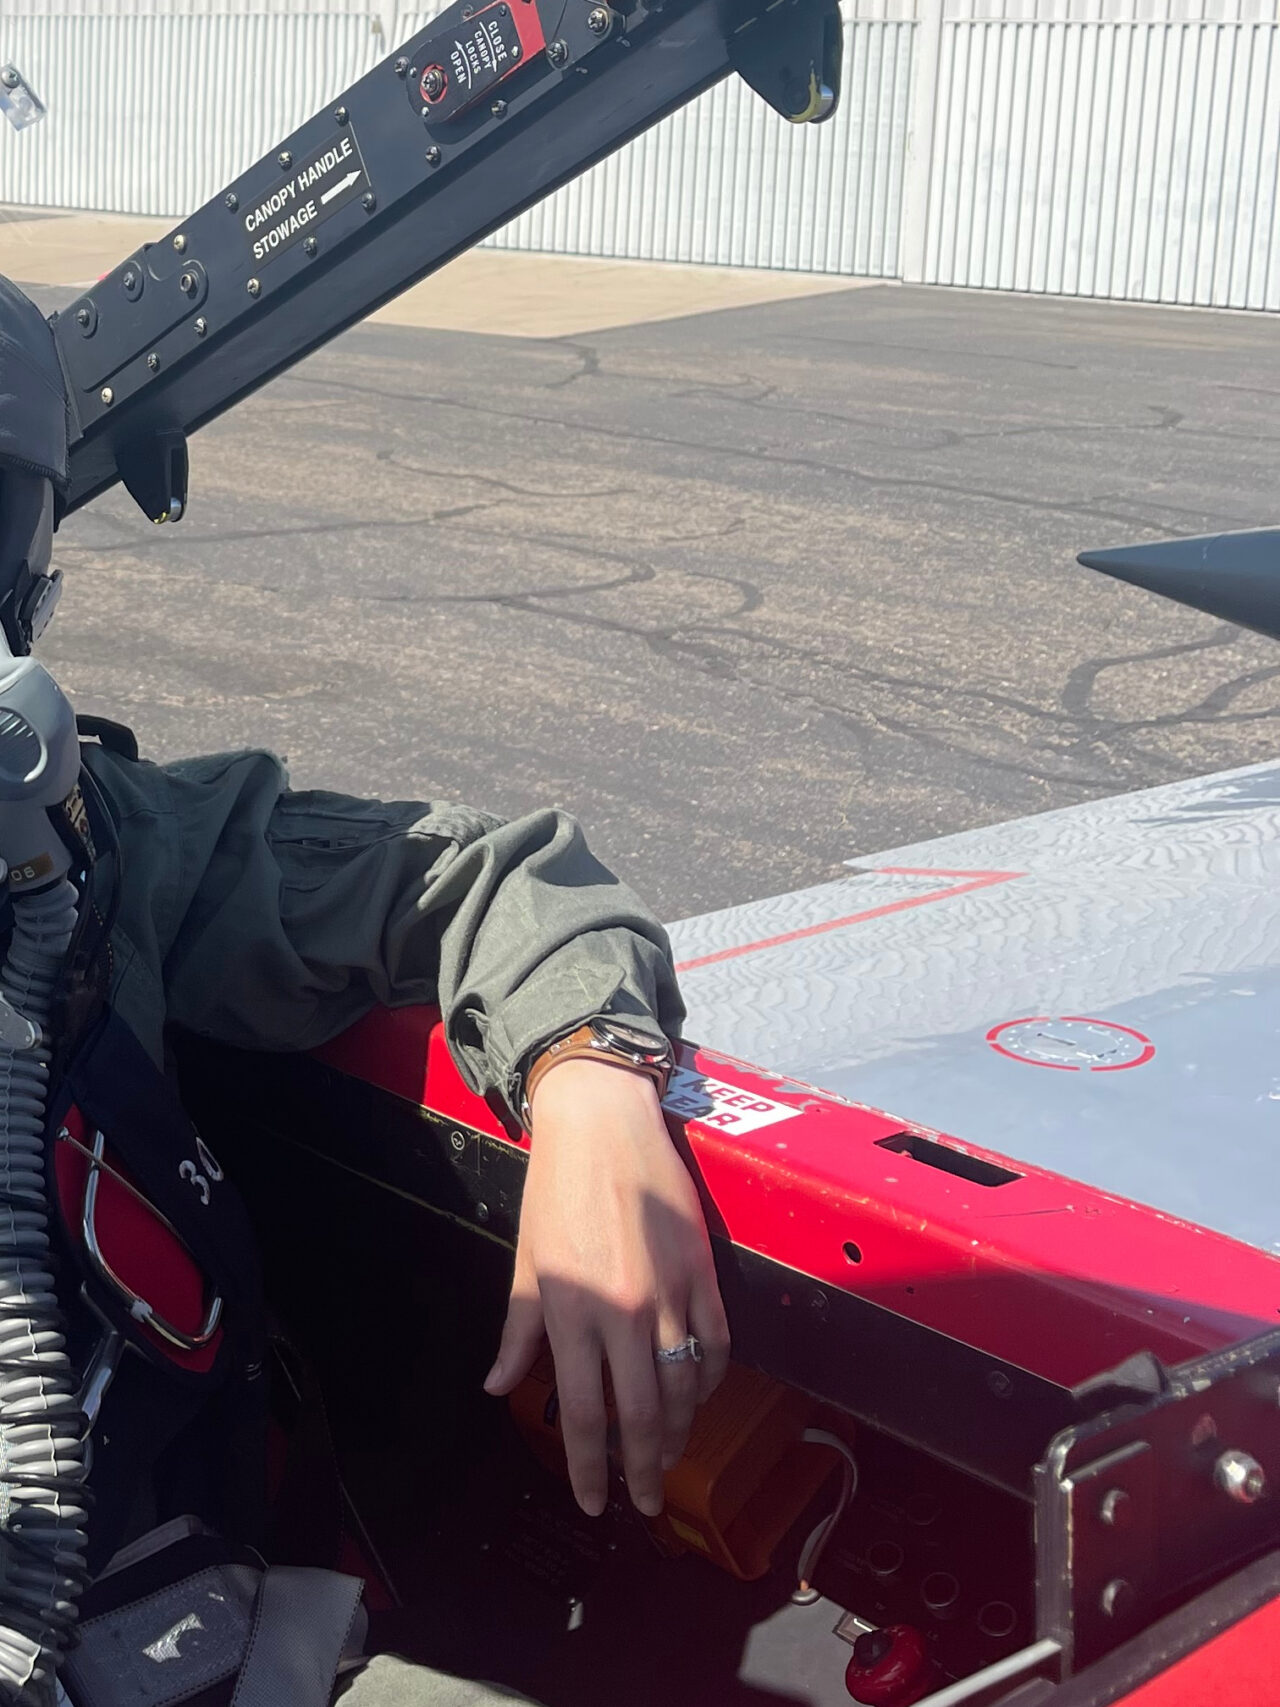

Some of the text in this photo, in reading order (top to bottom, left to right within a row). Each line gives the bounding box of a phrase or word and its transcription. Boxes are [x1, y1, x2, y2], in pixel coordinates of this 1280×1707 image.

[465, 41, 482, 74] LOCKS
[474, 31, 492, 69] CANOPY
[488, 21, 508, 62] CLOSE
[450, 51, 466, 84] OPEN
[245, 137, 353, 232] CANOPY HANDLE
[253, 199, 318, 259] STOWAGE
[665, 1091, 741, 1126] EAR
[680, 1077, 775, 1113] KEEP
[179, 1136, 224, 1205] 30
